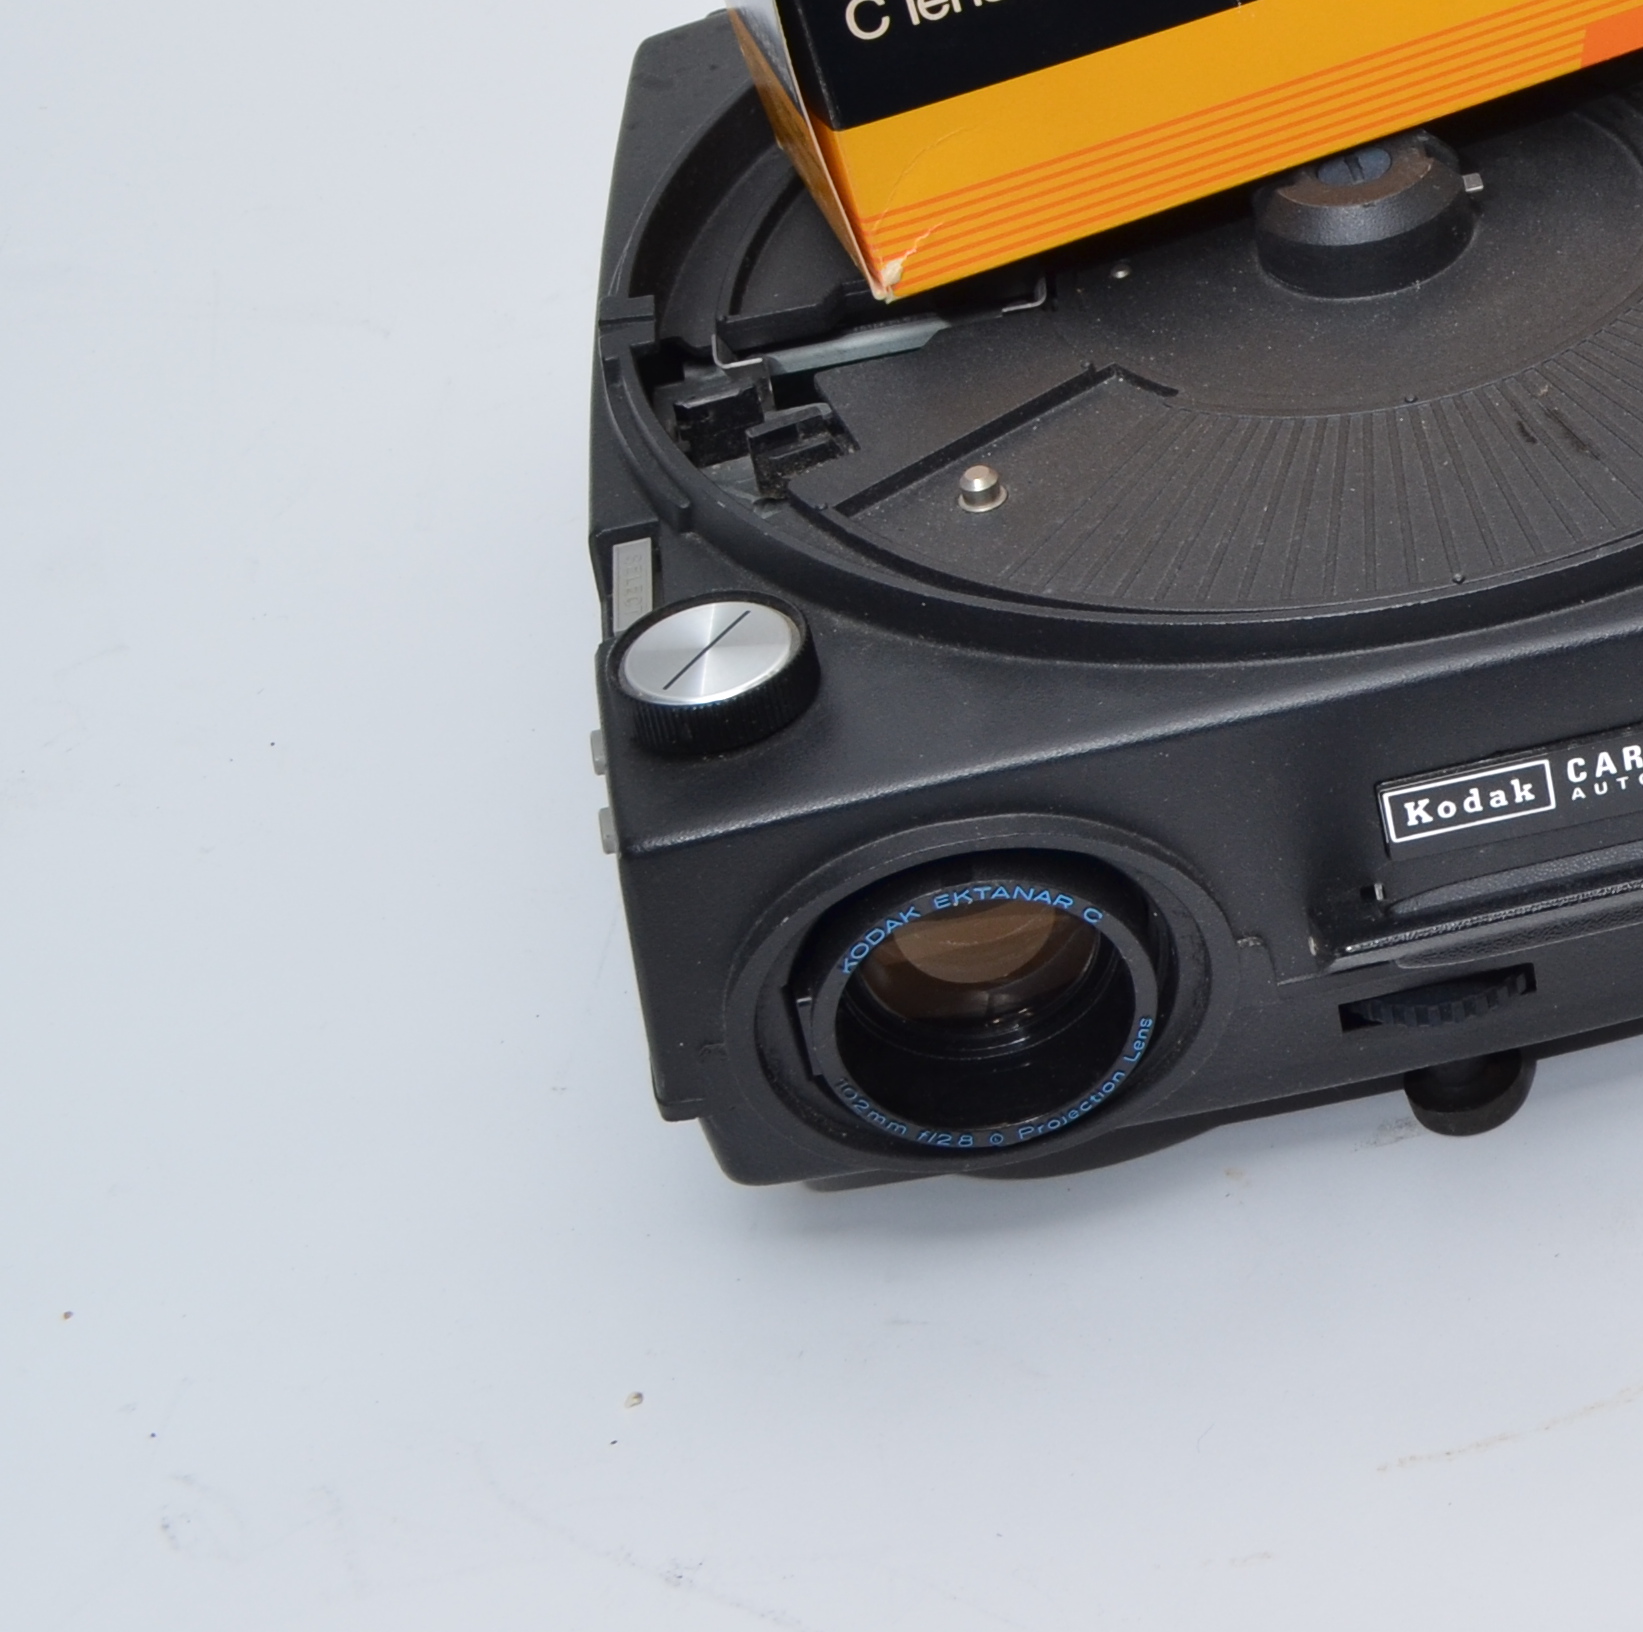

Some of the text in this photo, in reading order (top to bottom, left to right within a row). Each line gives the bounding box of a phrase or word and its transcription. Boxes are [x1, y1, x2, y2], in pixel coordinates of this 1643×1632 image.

[1404, 779, 1536, 827] Kodak
[842, 886, 1103, 973] KODAK EKTANAR C
[838, 1078, 907, 1135] 102mm
[1018, 1070, 1126, 1140] Projection
[1123, 1018, 1153, 1061] Lens
